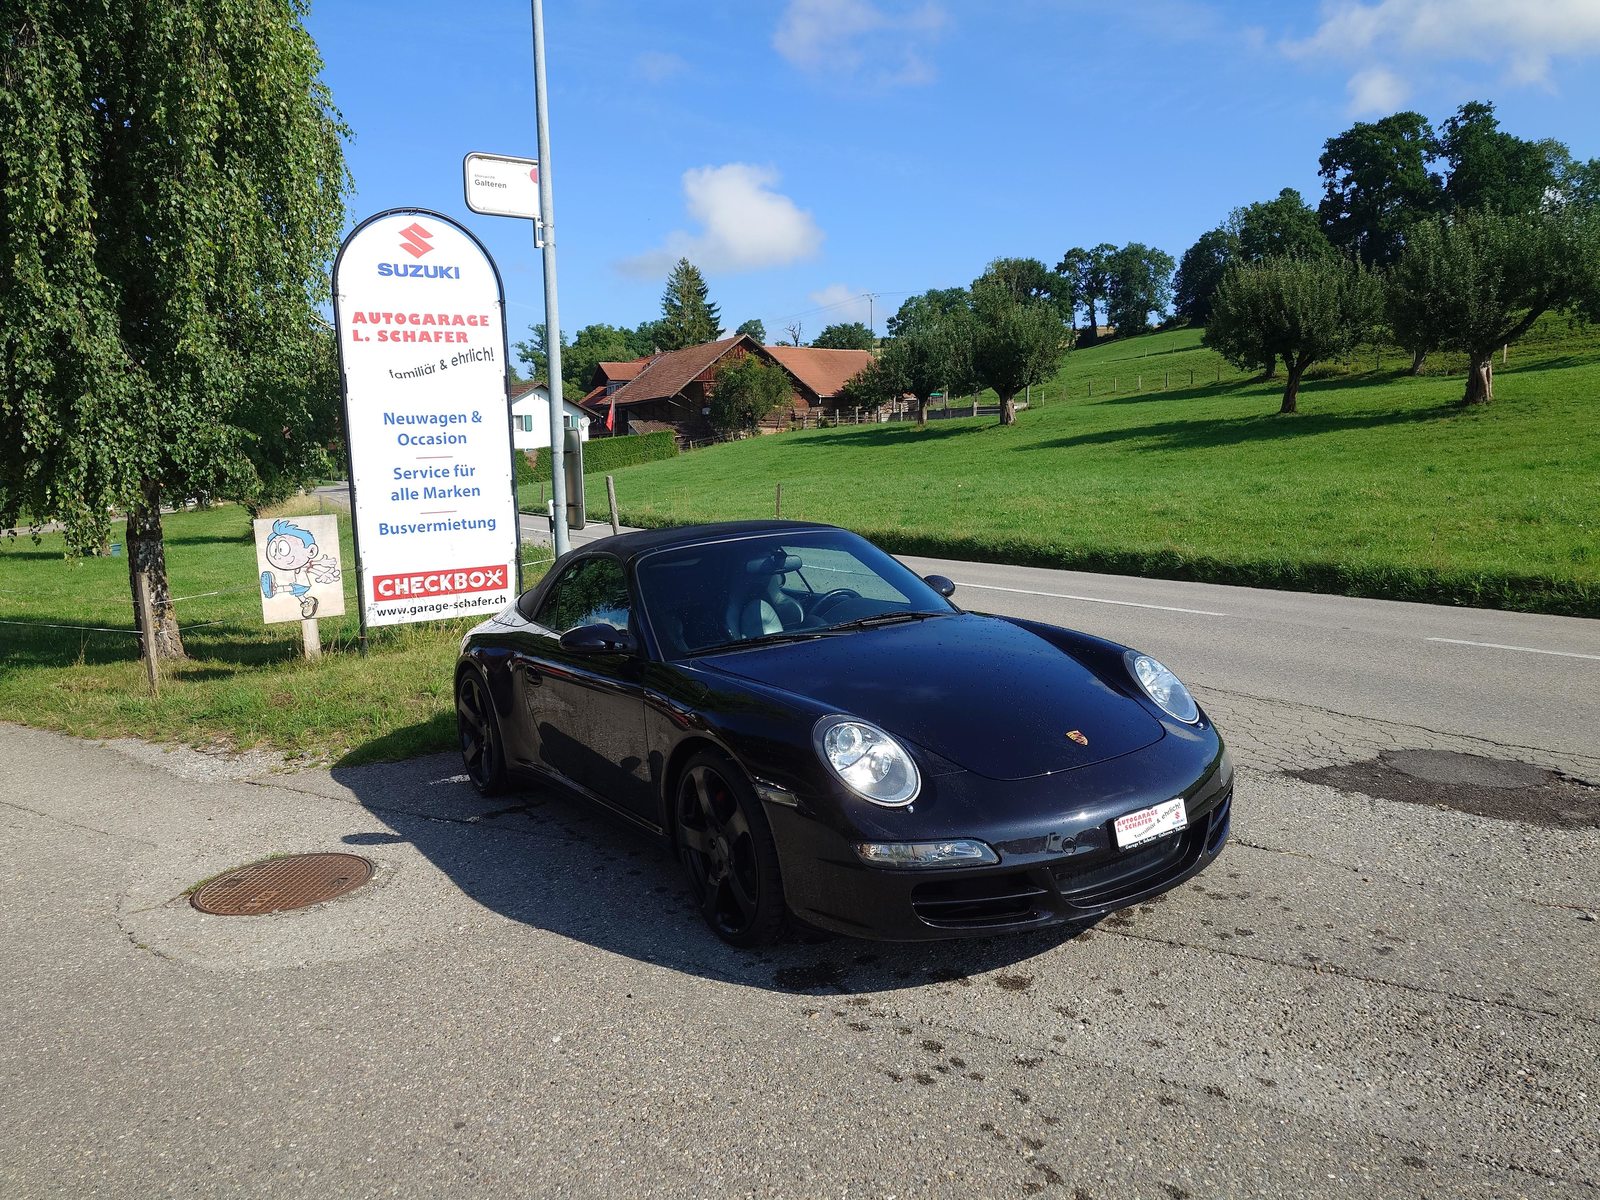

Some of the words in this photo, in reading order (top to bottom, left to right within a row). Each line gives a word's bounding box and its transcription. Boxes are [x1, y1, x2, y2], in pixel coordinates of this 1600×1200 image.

[474, 179, 507, 189] Galteren
[377, 262, 460, 279] SUZUKI
[352, 311, 490, 326] AUTOGARAGE
[352, 330, 370, 342] L.
[377, 330, 469, 343] SCHAFER
[388, 364, 436, 380] familiär
[439, 359, 448, 371] &
[451, 346, 495, 367] ehrlich!
[383, 411, 468, 427] Neuwagen
[471, 410, 482, 423] &
[397, 432, 467, 446] Occasion
[393, 466, 450, 480] Service
[453, 464, 476, 478] für
[390, 487, 419, 501] alle
[423, 485, 481, 500] Marken
[379, 518, 497, 536] Busvermietung
[377, 569, 504, 596] CHECKBOX
[376, 595, 507, 617] www.garage-schafer.ch
[1117, 809, 1158, 827] AUTOGARAGE
